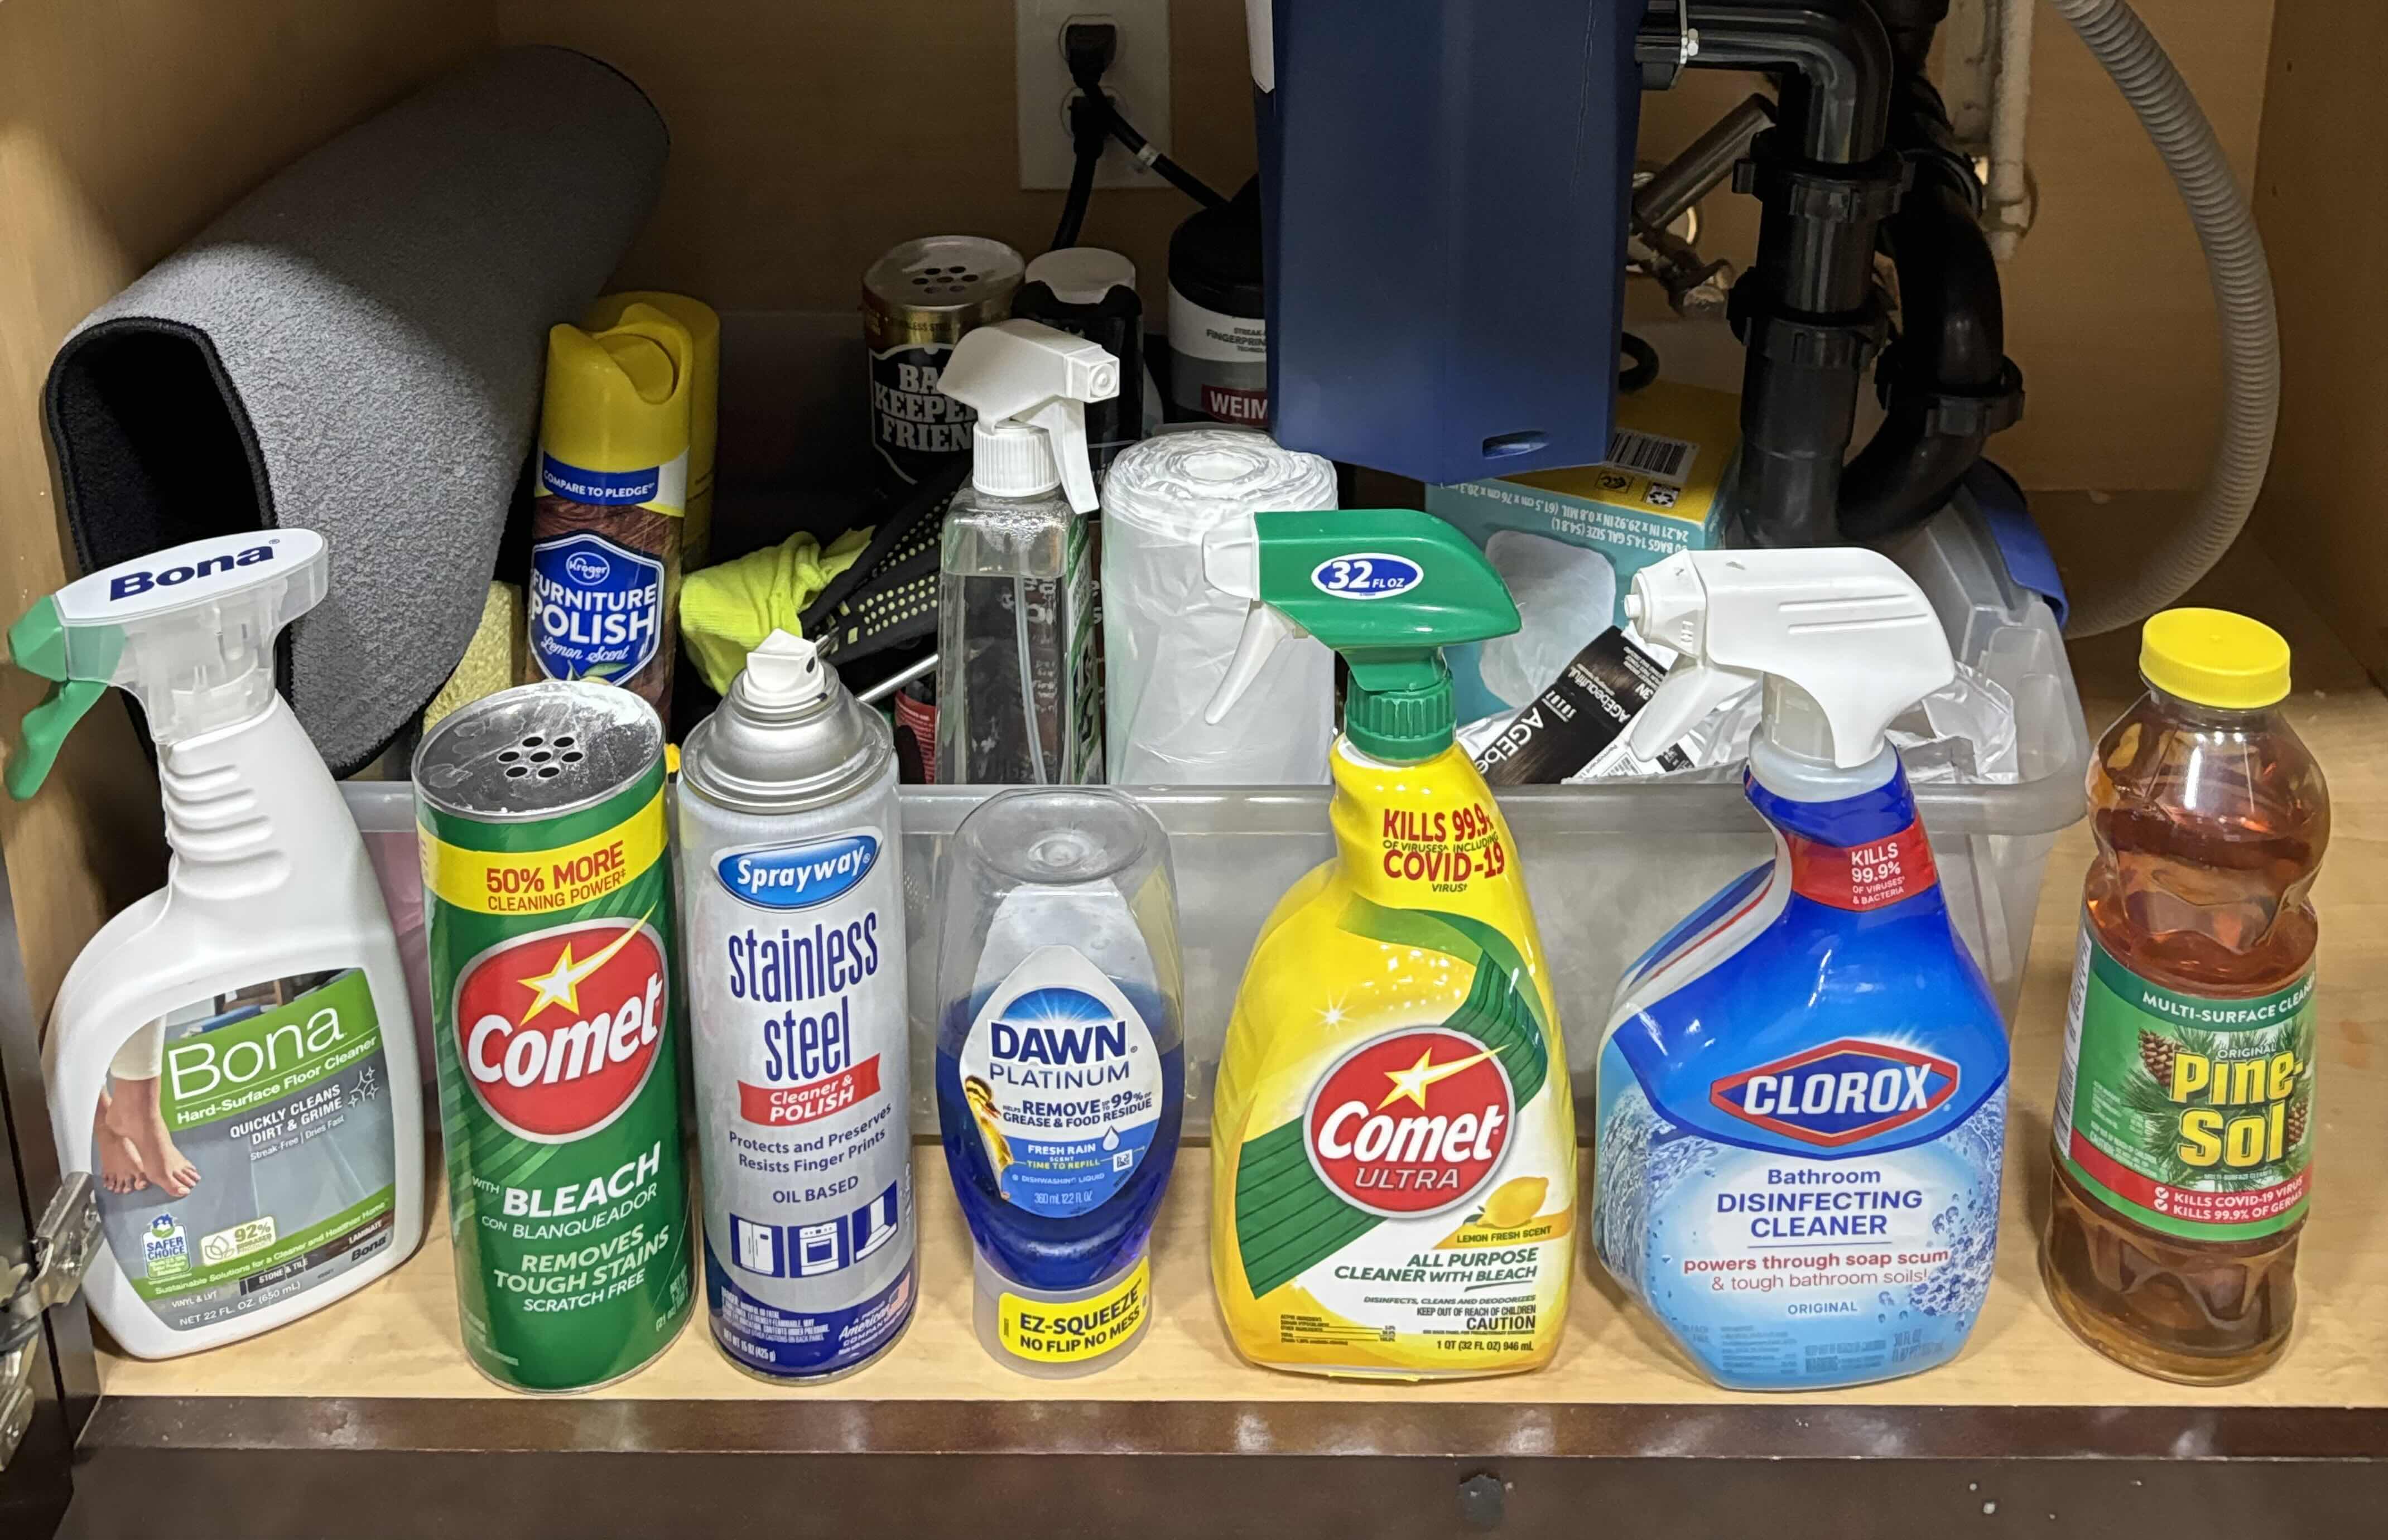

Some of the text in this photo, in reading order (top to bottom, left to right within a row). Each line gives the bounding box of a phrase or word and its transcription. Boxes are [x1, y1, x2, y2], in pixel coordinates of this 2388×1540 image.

[874, 380, 978, 423] KEEPE
[1209, 390, 1268, 420] WEIM
[882, 413, 974, 452] FRIEN
[543, 469, 603, 498] COMPARE TO
[1535, 499, 1689, 543] 24.21 0.8 MIL (61.5
[1586, 525, 1673, 553] BAGS 14.5 GAL SIZE
[109, 544, 275, 602] Bona
[568, 558, 608, 579] Kroger
[1327, 560, 1405, 589] 32 FL OZ
[532, 568, 657, 612] FURNITURE
[531, 591, 656, 645] POLISH
[540, 635, 630, 663] Lemon Scent
[1383, 808, 1446, 842] KILLS
[1383, 831, 1499, 853] OF INCLUDING
[1851, 842, 1899, 866] KILLS
[485, 840, 625, 894] 50% MORE
[736, 846, 865, 894] Sprayway
[1383, 842, 1505, 882] COVID-19
[1851, 861, 1901, 884] 99.9%
[488, 892, 566, 912] CLEANING
[1861, 886, 1904, 905] BACTERIA
[728, 911, 879, 1003] stainless
[2142, 991, 2276, 1024] MULTI-SURFACE
[467, 972, 664, 1088] Comet
[764, 995, 851, 1082] steel
[990, 1021, 1126, 1066] DAWN
[167, 1007, 345, 1102] Bona
[2217, 1042, 2277, 1060] ORIGINAL
[176, 1035, 377, 1125] Hard-Surface Floor Cleaner
[990, 1061, 1130, 1089] PLATINUM
[1743, 1063, 1932, 1116] CLOROX
[2170, 1050, 2304, 1105] Pine-
[770, 1079, 838, 1105] Cleaner
[770, 1085, 855, 1123] POLISH
[229, 1084, 341, 1139] QUICKLY CLEANS
[252, 1098, 343, 1145] DIRT & GRIME
[1003, 1098, 1152, 1128] GREASE FOOD RESIDUE
[1023, 1099, 1101, 1117] REMOVE
[305, 1114, 345, 1140] Dries Fast
[729, 1104, 892, 1154] Protects and Preserves
[1317, 1100, 1505, 1163] Comet
[2178, 1102, 2285, 1168] Sol
[739, 1128, 886, 1173] Resists Finger Prints
[1028, 1143, 1096, 1155] FRESH RAIN
[1027, 1158, 1101, 1170] TIME REFILL
[1355, 1166, 1459, 1190] ULTRA
[1767, 1169, 1881, 1186] Bathroom
[472, 1140, 661, 1218] WITH BLEACH
[773, 1175, 859, 1204] OIL BASED
[2174, 1192, 2212, 1208] KILLS
[2215, 1191, 2274, 1208] COVID-19
[2276, 1175, 2304, 1199] VIRUS
[482, 1181, 658, 1240] CON BLANQUEADOR
[1717, 1190, 1923, 1213] DISINFECTING
[2173, 1187, 2303, 1220] KILLS 99.9% OF GERMS
[234, 1222, 272, 1243] 92%
[348, 1219, 383, 1244] LAMINATE
[1457, 1225, 1552, 1244] LEMON FRESH SCENT
[1750, 1214, 1888, 1238] CLEANER
[146, 1235, 184, 1253] SAFER
[147, 1245, 186, 1261] CHOICE
[155, 1277, 208, 1295] Sustainable
[209, 1263, 251, 1282] Solutions
[273, 1241, 306, 1261] Cleaner
[362, 1201, 386, 1220] Home
[350, 1234, 387, 1263] Bona
[521, 1223, 644, 1273] REMOVES
[1407, 1247, 1539, 1268] ALL PURPOSE
[493, 1225, 670, 1295] TOUGH STAINS
[1334, 1265, 1538, 1282] CLEANER WITH BLEACH
[1683, 1249, 1949, 1274] powers through soap scum
[258, 1268, 283, 1284] STONE
[523, 1288, 604, 1312] SCRATCH
[608, 1268, 646, 1299] FREE
[1711, 1268, 1928, 1293] & tough bathroom soils!
[171, 1298, 195, 1309] VINYL
[179, 1280, 301, 1326] NET 22 (650 mL)
[1019, 1286, 1139, 1336] EZ-SQUEEZE
[1417, 1304, 1536, 1317] KEEP OUT REACH CHILDREN
[1479, 1294, 1536, 1305] DEODORIZES
[1787, 1301, 1858, 1316] ORIGINAL
[1020, 1305, 1140, 1353] NO FLIP NO MESS
[1466, 1315, 1536, 1331] CAUTION
[1444, 1340, 1519, 1351] QT (32 946
